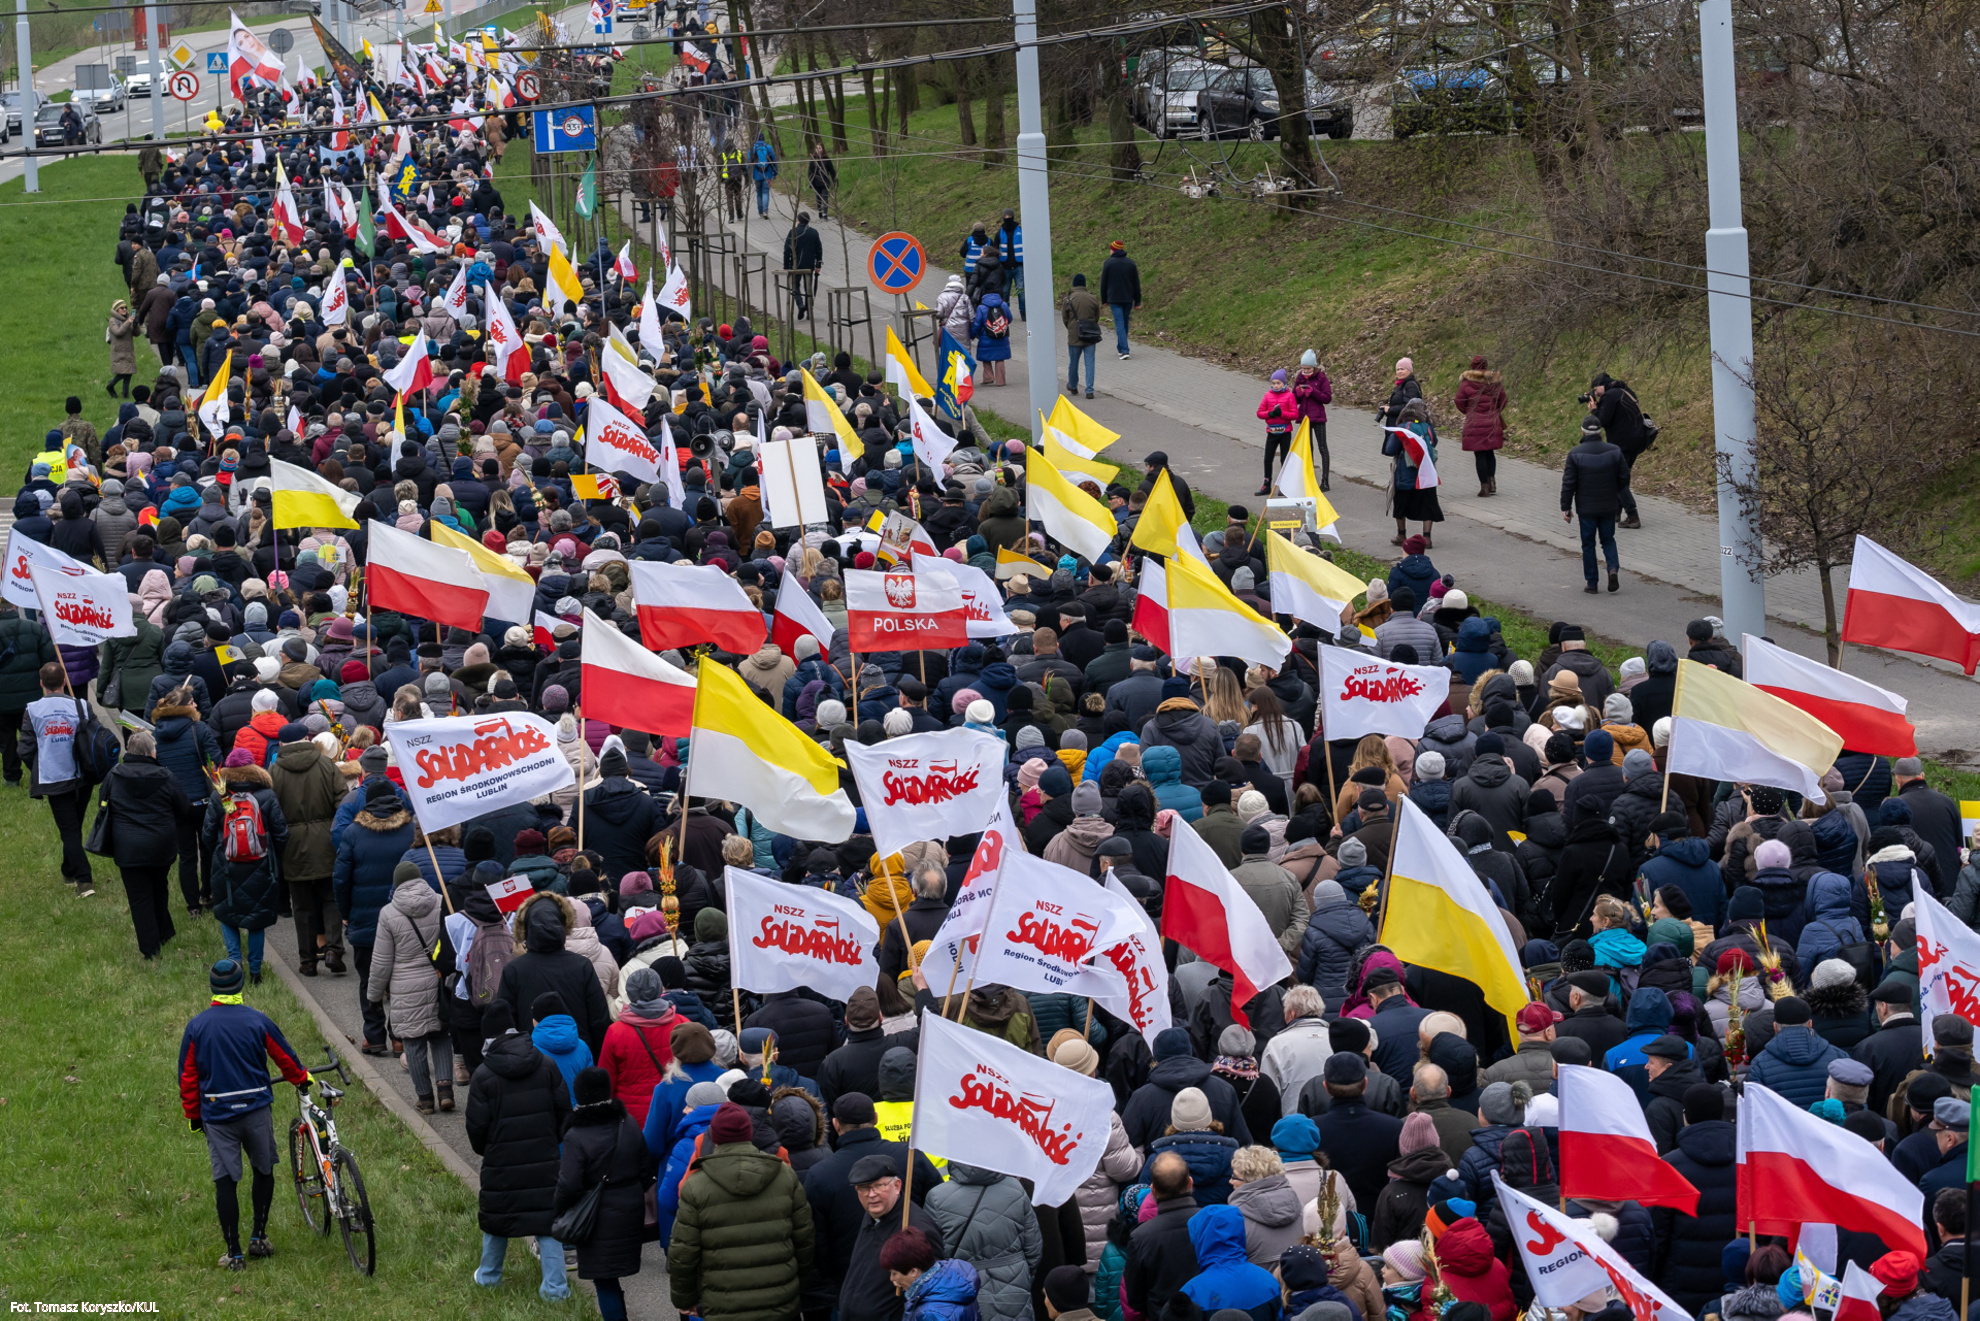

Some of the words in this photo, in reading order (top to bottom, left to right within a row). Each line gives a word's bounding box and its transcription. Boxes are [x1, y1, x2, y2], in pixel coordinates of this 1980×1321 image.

[612, 420, 631, 431] NSZZ
[11, 580, 35, 593] REGION
[873, 617, 939, 632] POLSKA
[1354, 665, 1380, 675] NSZZ
[406, 735, 433, 749] NSZZ
[888, 759, 919, 769] NSZZ
[426, 789, 459, 805] REGION
[460, 757, 555, 795] ŚRODKOWOWSCHODNI
[476, 783, 508, 799] LUBLIN
[774, 904, 805, 918] NSZZ
[1036, 900, 1063, 916] NSZZ
[1129, 933, 1146, 956] SZZ
[1003, 948, 1035, 963] Region
[976, 1063, 1012, 1087] NSZZ
